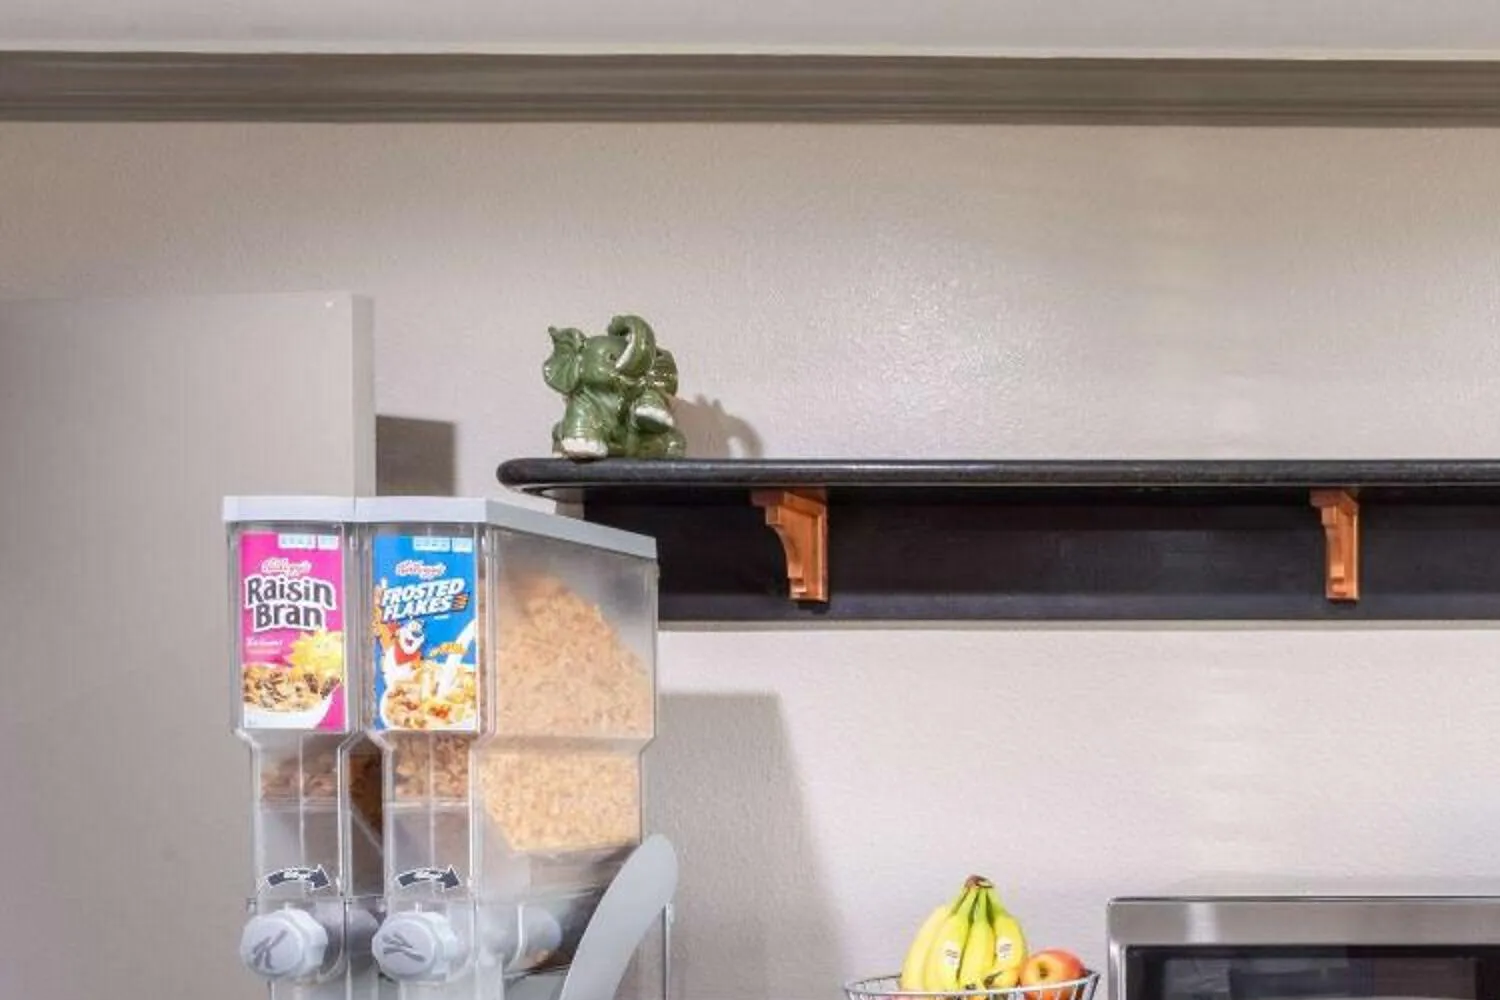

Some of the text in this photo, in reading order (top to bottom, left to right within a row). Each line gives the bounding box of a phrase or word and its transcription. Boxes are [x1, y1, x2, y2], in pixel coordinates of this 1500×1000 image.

[246, 577, 334, 608] Raisin
[381, 578, 465, 607] FROSTED
[255, 603, 323, 629] Bran
[383, 596, 453, 621] FLAKES
